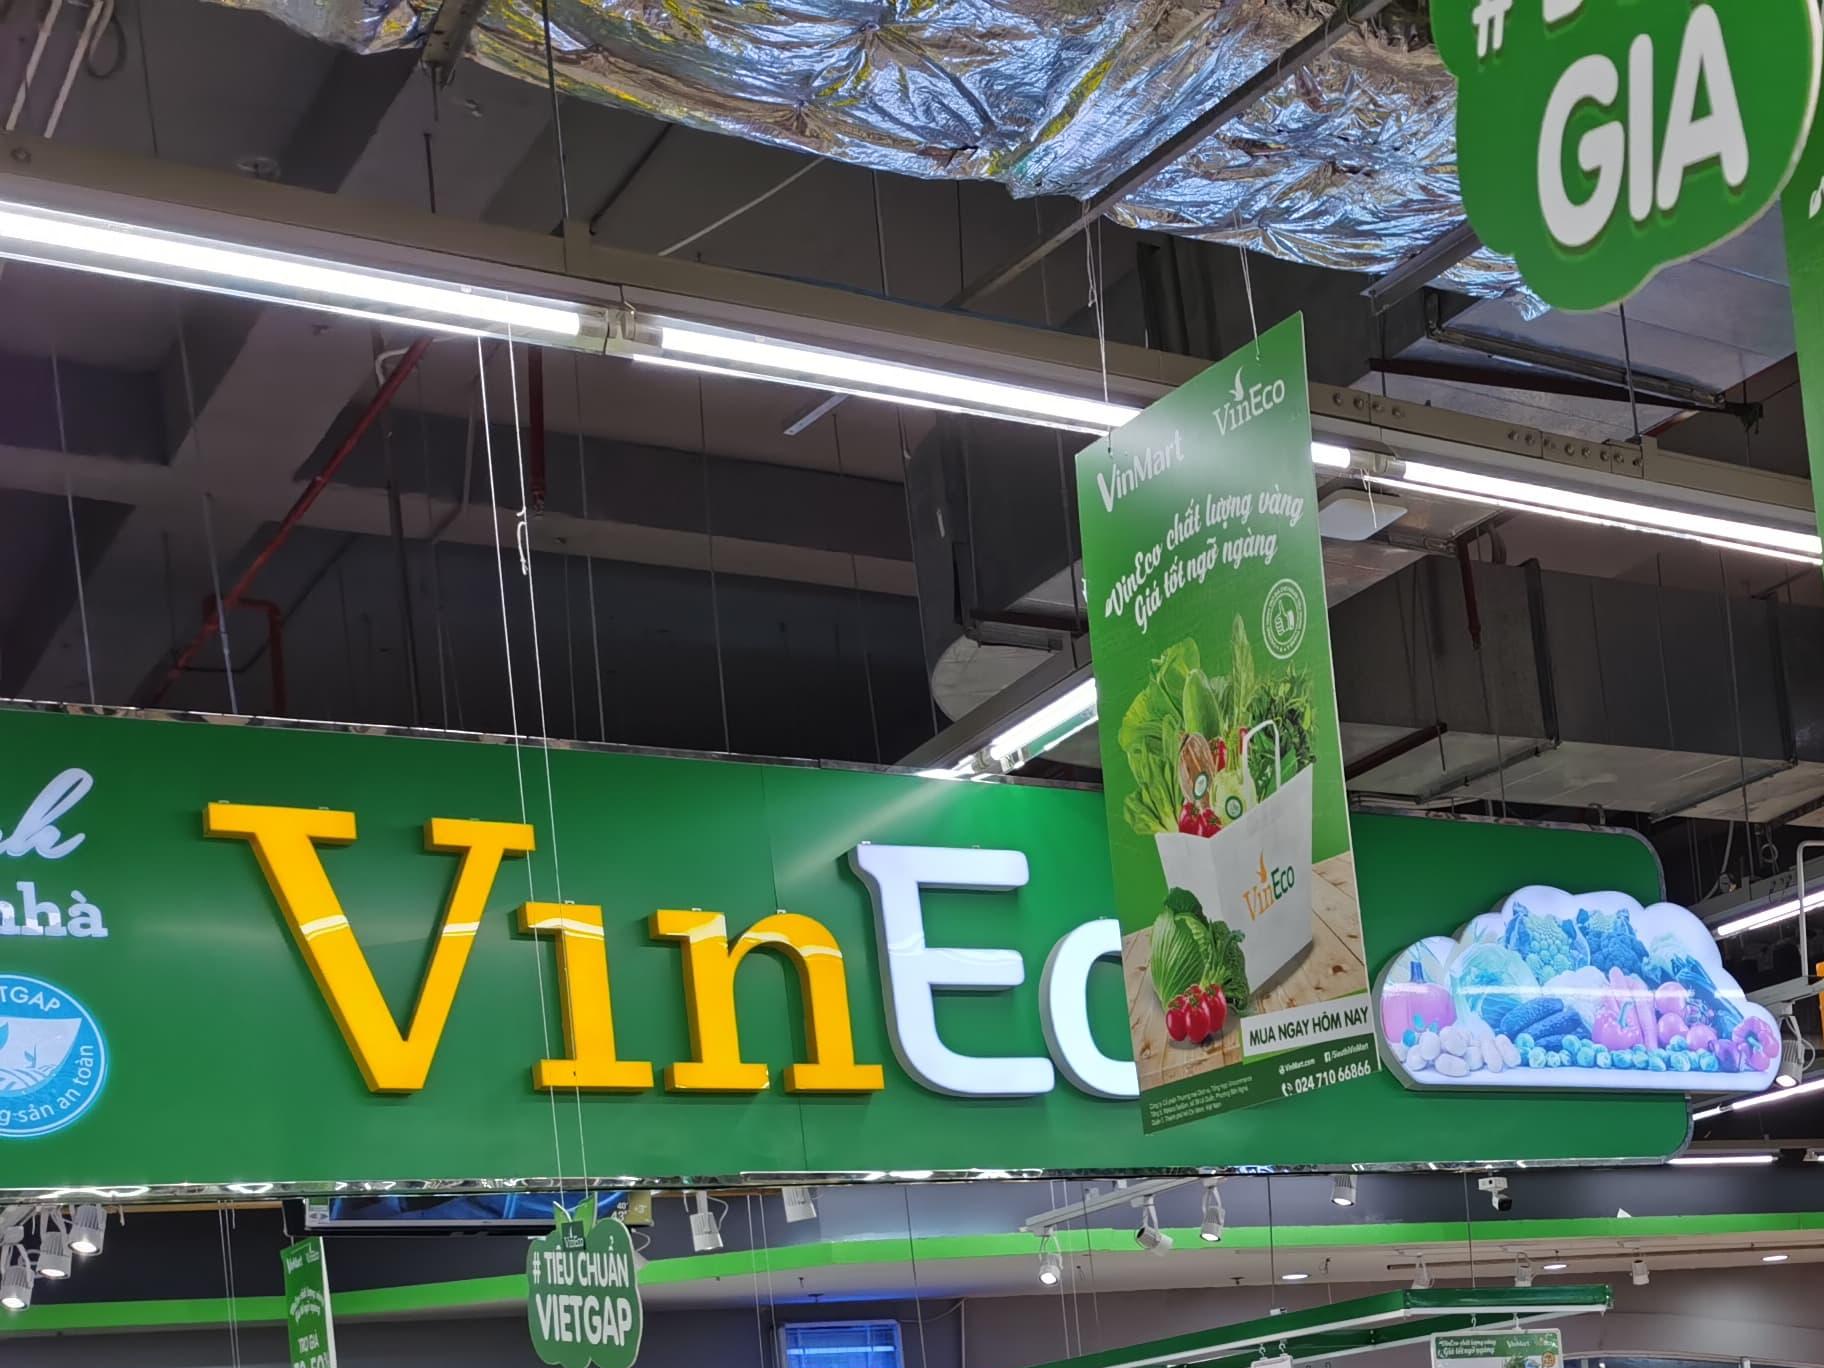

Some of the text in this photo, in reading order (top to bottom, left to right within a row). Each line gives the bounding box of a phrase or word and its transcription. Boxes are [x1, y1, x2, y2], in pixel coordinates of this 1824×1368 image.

[1096, 378, 1285, 513] VinMart VinEco
[1105, 484, 1304, 619] VinEco chất lượng vàng
[1134, 529, 1278, 635] Giá tốt ngỡ ngàng
[1242, 864, 1296, 921] VinEco
[203, 802, 1140, 1099] VinEc
[1249, 1006, 1369, 1047] MUA NGAY HÔM NAY
[17, 1102, 55, 1123] sản
[56, 1088, 81, 1110] an
[76, 1045, 95, 1086] toàn
[1295, 1060, 1371, 1094] 024 710 66866
[544, 1235, 629, 1288] TIÊU CHUẨN
[535, 1293, 633, 1346] VIETGAP
